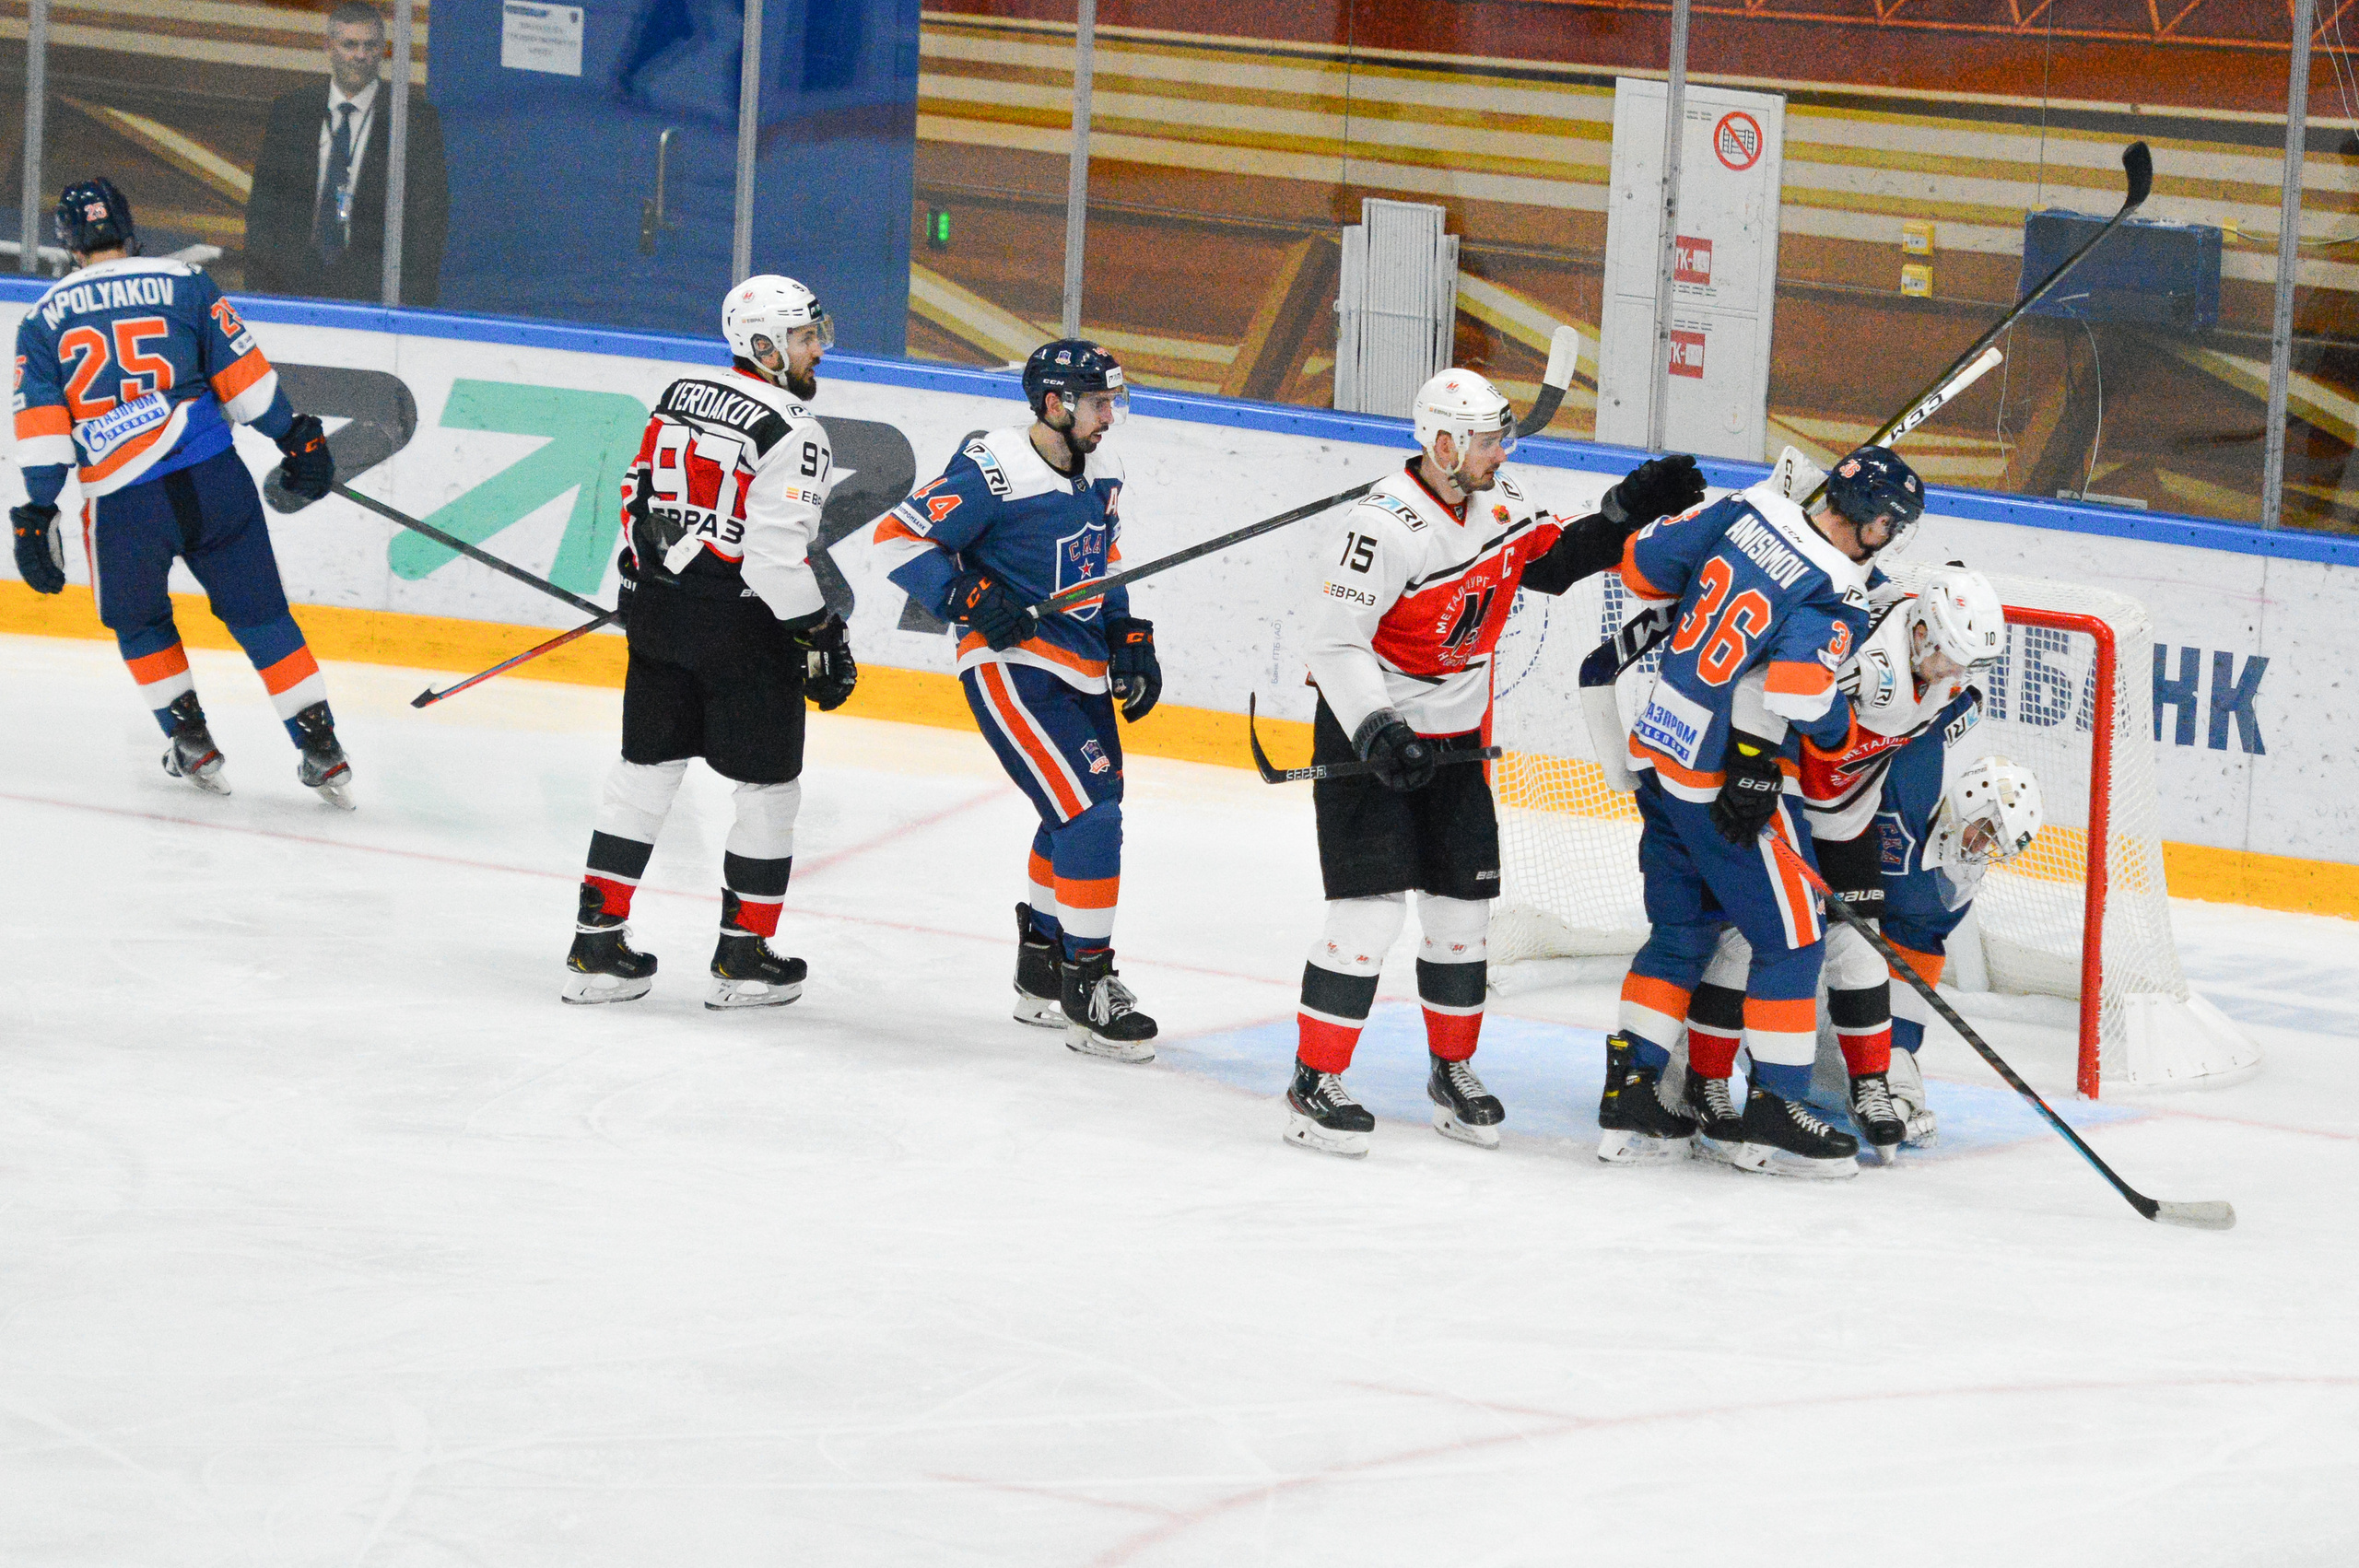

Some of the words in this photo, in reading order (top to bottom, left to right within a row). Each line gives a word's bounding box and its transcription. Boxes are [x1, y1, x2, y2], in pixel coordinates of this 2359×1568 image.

[58, 316, 175, 424] 25
[1042, 378, 1064, 386] CCM
[667, 381, 769, 431] YERDAKOV
[1890, 392, 1944, 442] CCM
[651, 423, 746, 518] 97
[800, 440, 830, 483] 97
[1105, 486, 1119, 516] A
[1068, 532, 1102, 563] СКА
[1339, 531, 1378, 574] 15
[1724, 512, 1811, 591] ANISIMOV
[1781, 524, 1804, 544] CCM
[1330, 583, 1377, 607] ЕВРАЗ
[1670, 555, 1772, 687] 36
[1984, 631, 1997, 646] 10
[1645, 701, 1698, 746] АЗПРОМ
